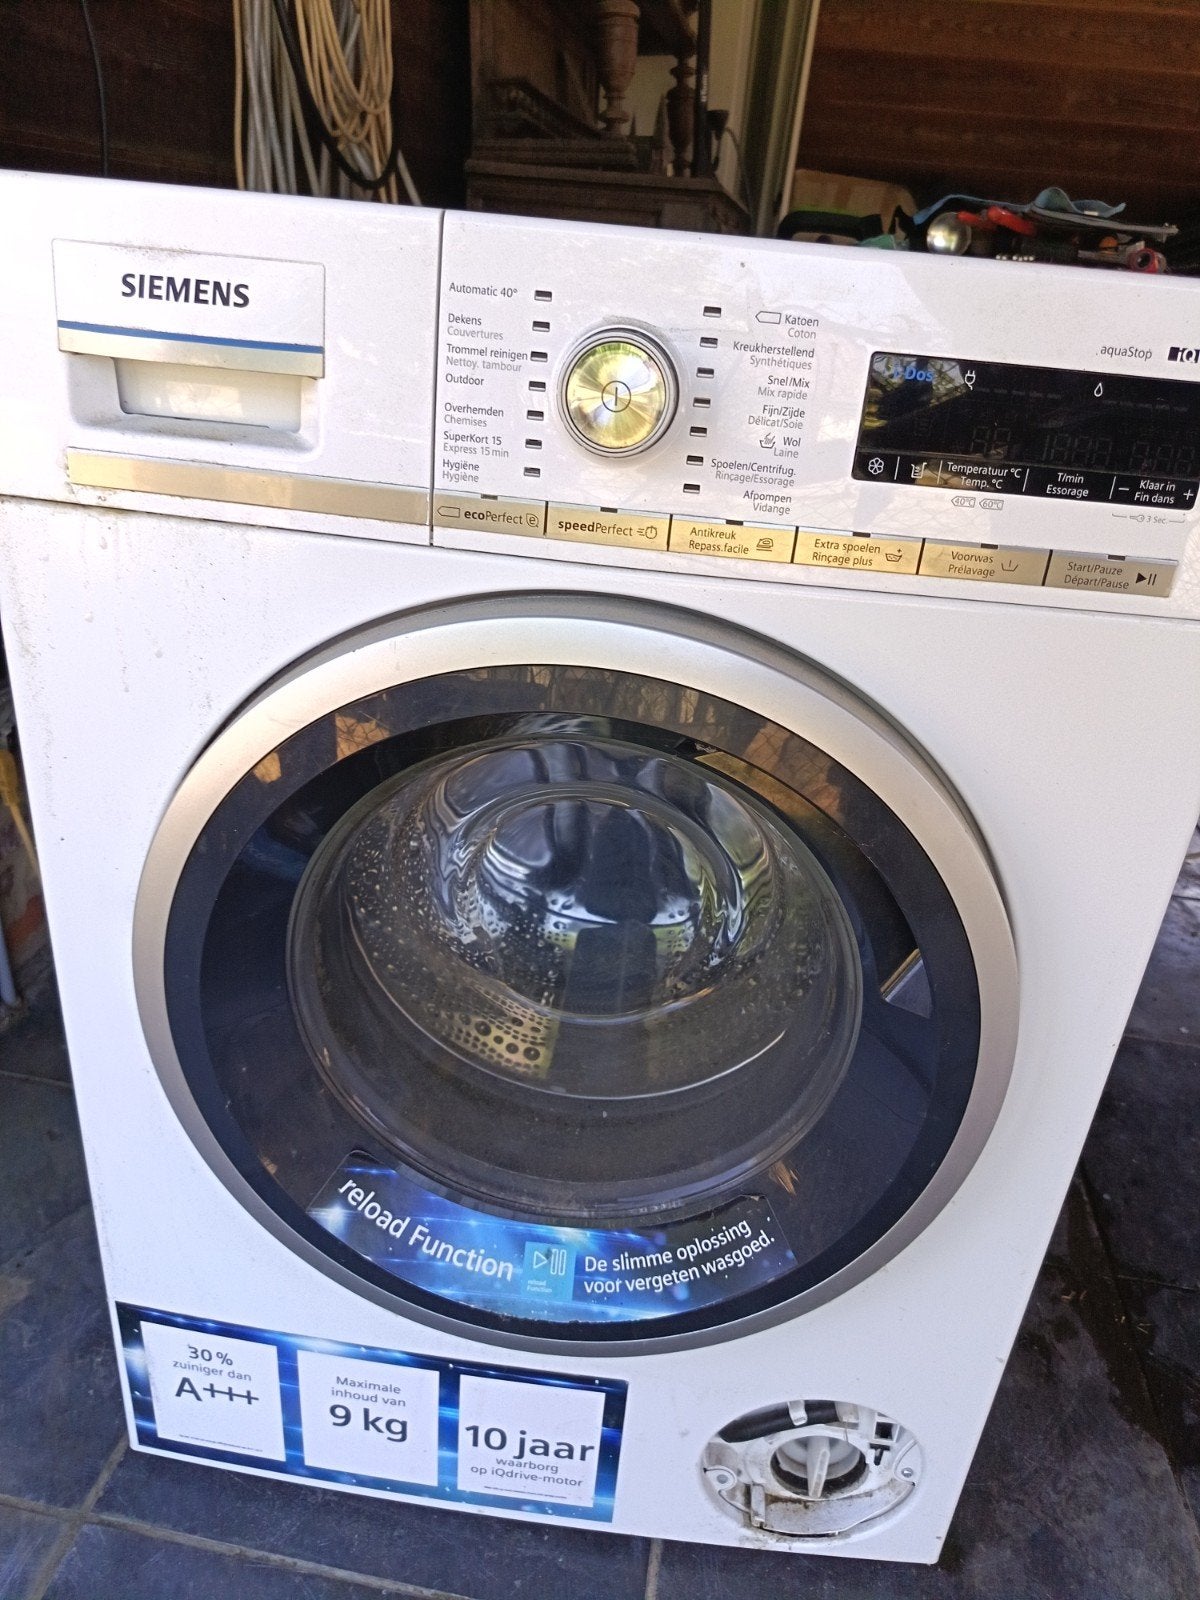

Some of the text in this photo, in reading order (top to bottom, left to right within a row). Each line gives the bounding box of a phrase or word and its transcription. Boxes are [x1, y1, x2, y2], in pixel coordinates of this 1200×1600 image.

[120, 272, 250, 309] SIEMENS
[449, 282, 498, 297] Automatic
[448, 313, 482, 326] Dekens
[784, 314, 819, 327] Katoen
[447, 326, 504, 341] Couvertures
[787, 328, 817, 339] Coton
[447, 343, 528, 362] Trommel reinigen
[733, 341, 815, 358] Kreukherstellend
[1100, 346, 1153, 361] aquaStop
[446, 356, 522, 372] Nettoy. tambour
[750, 355, 813, 371] Synthétiques
[445, 373, 485, 386] Outdoor
[767, 375, 810, 389] Snel/Mix
[757, 386, 808, 401] Mix rapide
[444, 402, 504, 417] Overhemden
[762, 404, 805, 418] Fijn/Zijde
[443, 414, 488, 428] Chemises
[748, 415, 804, 430] Délicat/Soie
[443, 430, 502, 446] SuperKort 15
[783, 436, 801, 447] Wol
[443, 443, 478, 456] Express
[773, 447, 799, 459] Laine
[442, 459, 480, 472] Hygiëne
[711, 458, 796, 477] Spoelen/Centrifug.
[947, 461, 1008, 477] Temperatuur
[442, 470, 480, 484] Hygiène
[715, 470, 795, 488] Rinçage/Essorage
[961, 476, 989, 488] Temp.
[1057, 472, 1084, 484] T/min
[1046, 484, 1089, 497] Essorage
[1139, 479, 1176, 492] Klaar in
[743, 490, 792, 504] Afpompen
[1134, 492, 1175, 504] Fin dans
[752, 502, 791, 515] Vidange
[464, 508, 523, 525] ecoPerfect
[558, 518, 633, 537] speedPerfect
[690, 526, 736, 540] Antikreuk
[814, 538, 881, 555] Extra spoelen
[812, 552, 873, 567] Rinçage plus
[951, 550, 994, 564] Voorwas
[948, 563, 995, 578] Prélavage
[1067, 561, 1123, 576] Start/Pauze
[1064, 574, 1130, 590] Départ/Pause
[337, 1178, 515, 1282] reload Function
[584, 1218, 752, 1272] De slimme oplossing
[583, 1229, 776, 1294] voor vergeten wasgoed.
[172, 1360, 252, 1381] zuiniger dan
[175, 1376, 260, 1405] A+++
[336, 1375, 401, 1394] Maximale
[331, 1387, 406, 1407] inhoud van
[329, 1404, 408, 1443] 9 kg
[465, 1424, 595, 1462] 10 jaar
[495, 1457, 559, 1474] waarborg
[470, 1465, 584, 1487] op iQdrive-motor
